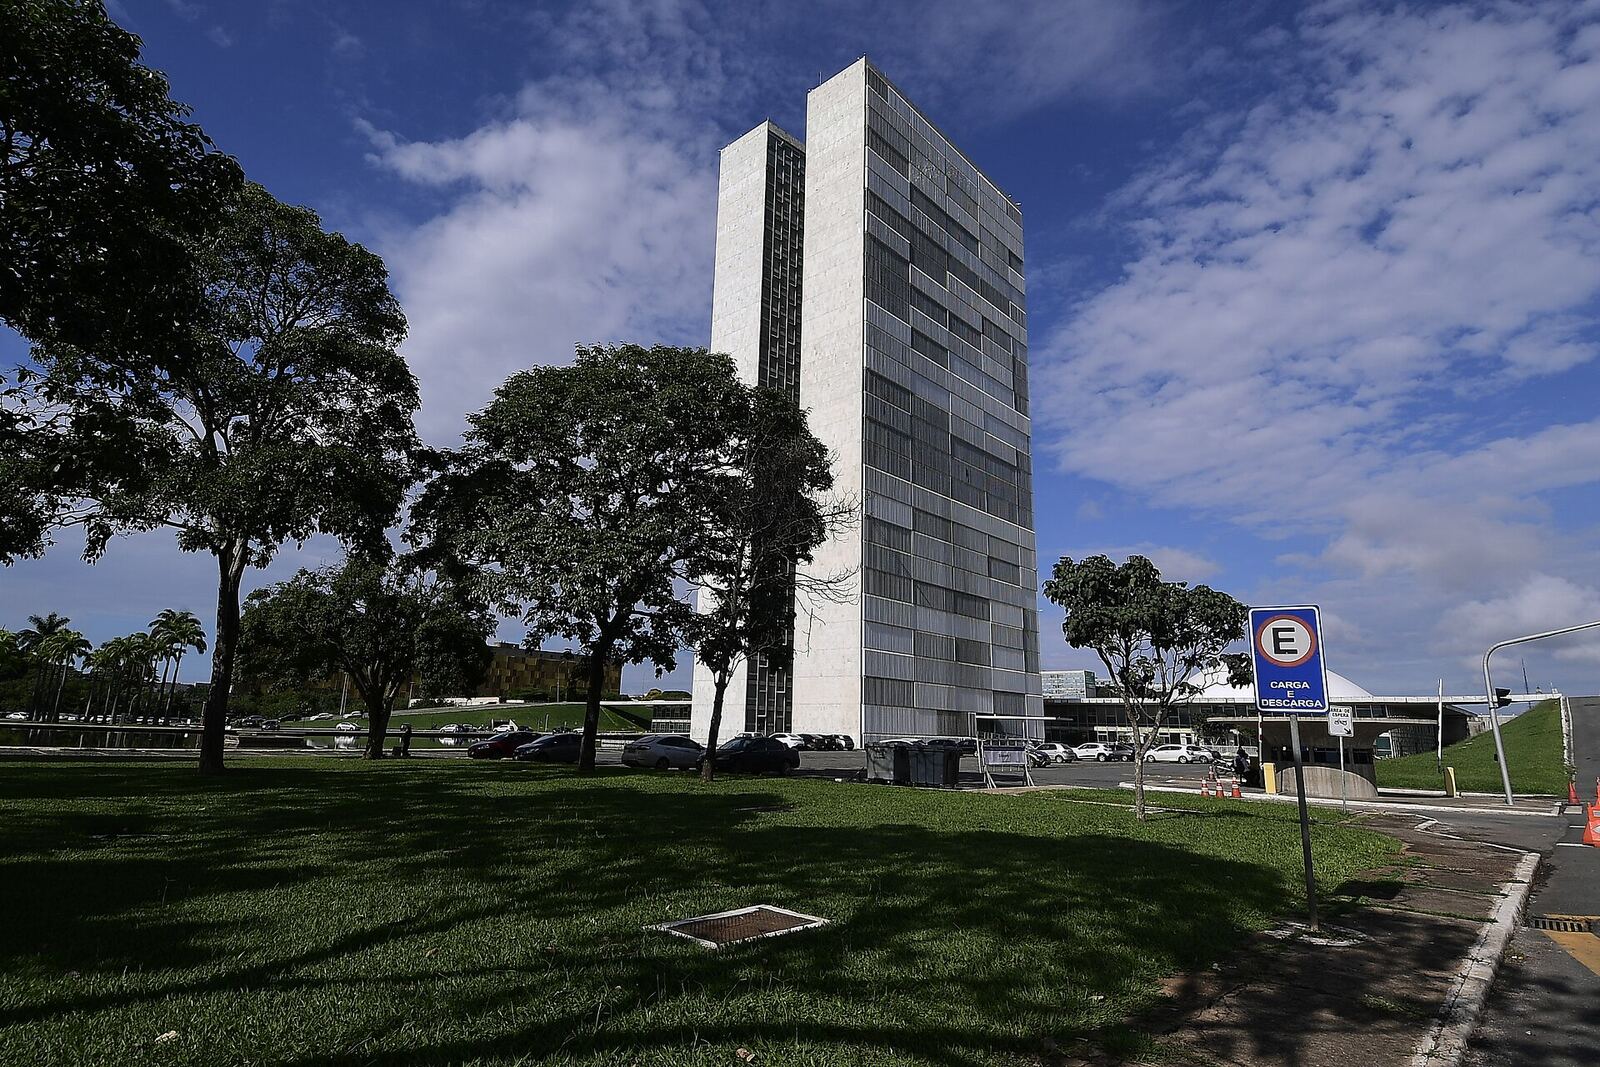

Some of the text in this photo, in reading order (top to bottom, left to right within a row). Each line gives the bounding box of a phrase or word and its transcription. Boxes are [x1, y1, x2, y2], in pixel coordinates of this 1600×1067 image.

[1272, 627, 1298, 654] E
[1270, 681, 1310, 689] CARGA
[1287, 690, 1295, 698] E
[1261, 699, 1323, 708] DESCARGA
